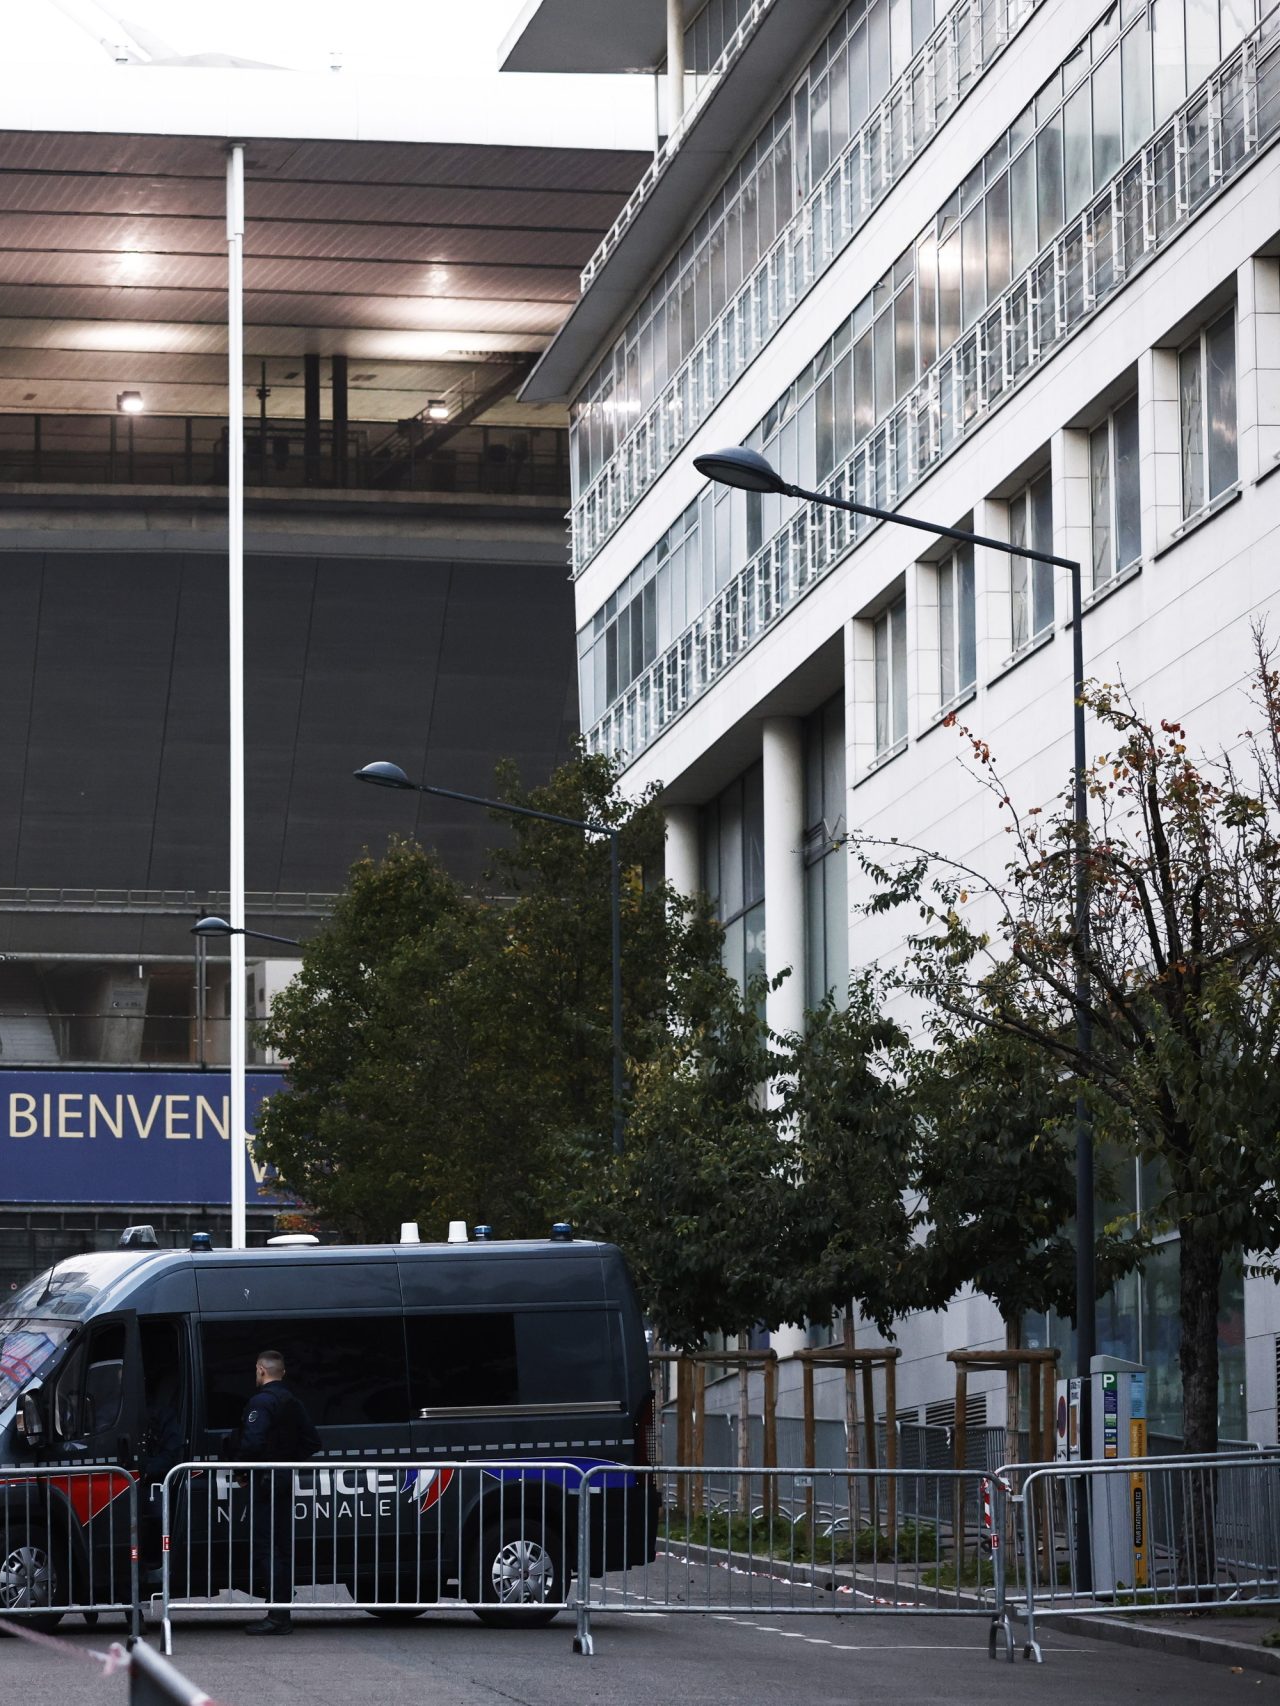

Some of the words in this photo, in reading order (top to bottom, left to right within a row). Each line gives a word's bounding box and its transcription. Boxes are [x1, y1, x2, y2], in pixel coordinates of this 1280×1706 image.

[1103, 1374, 1114, 1388] P
[216, 1467, 397, 1499] PLICE
[218, 1500, 391, 1522] NONALE
